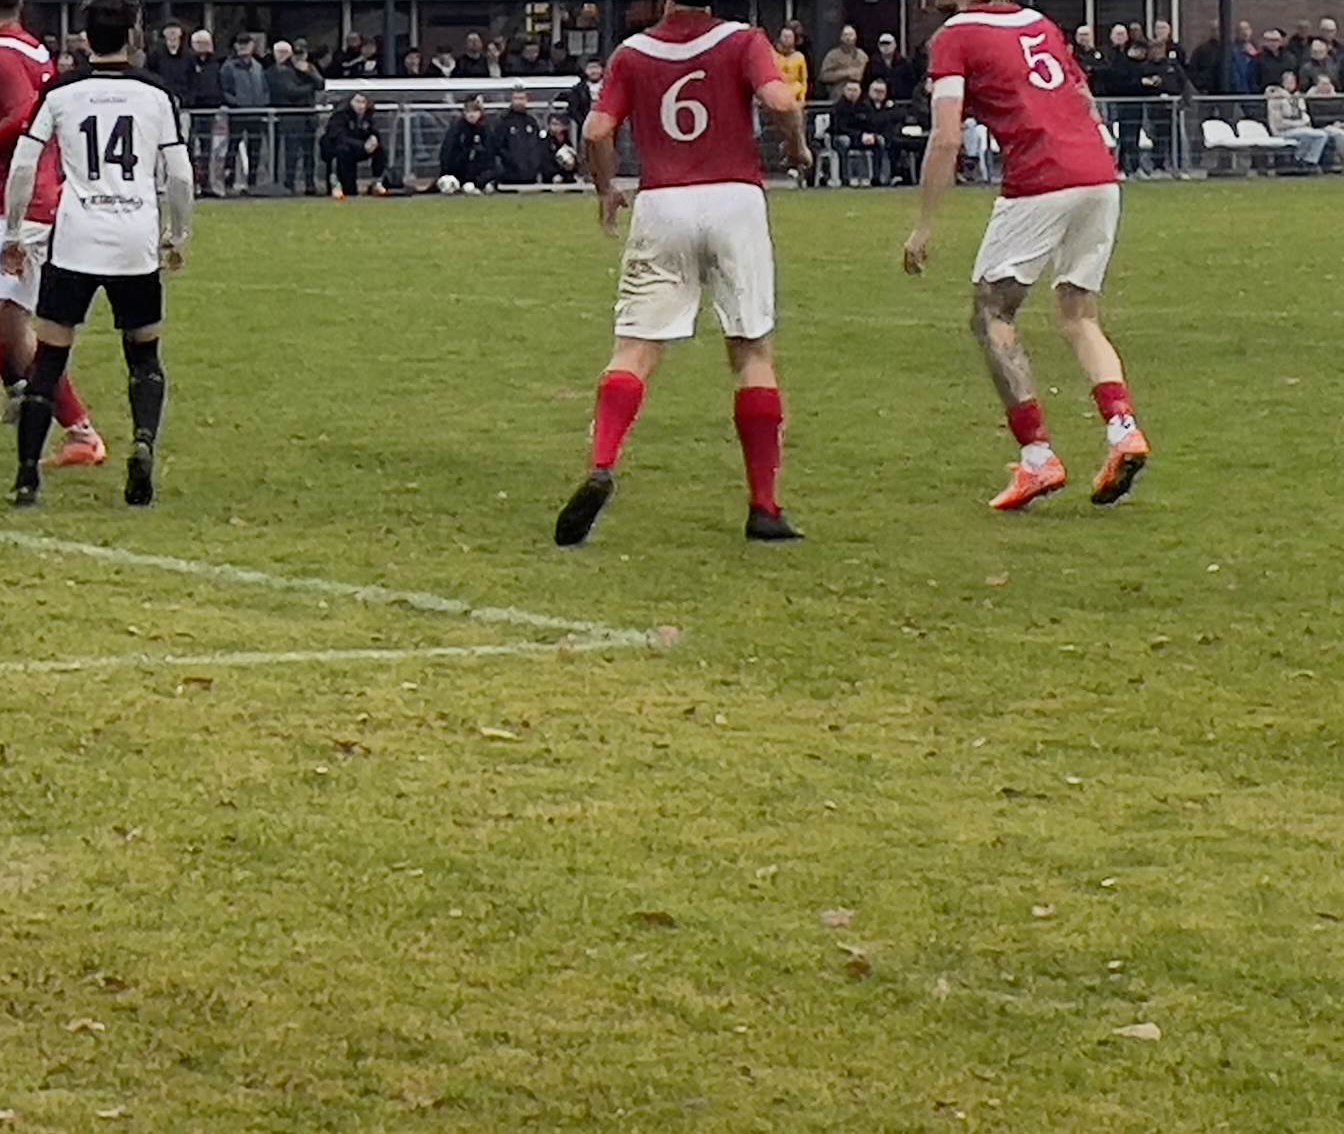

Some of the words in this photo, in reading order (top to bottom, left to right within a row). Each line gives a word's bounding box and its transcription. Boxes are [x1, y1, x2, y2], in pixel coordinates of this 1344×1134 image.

[1019, 32, 1065, 90] 5
[660, 69, 709, 142] 6
[79, 115, 139, 181] 14
